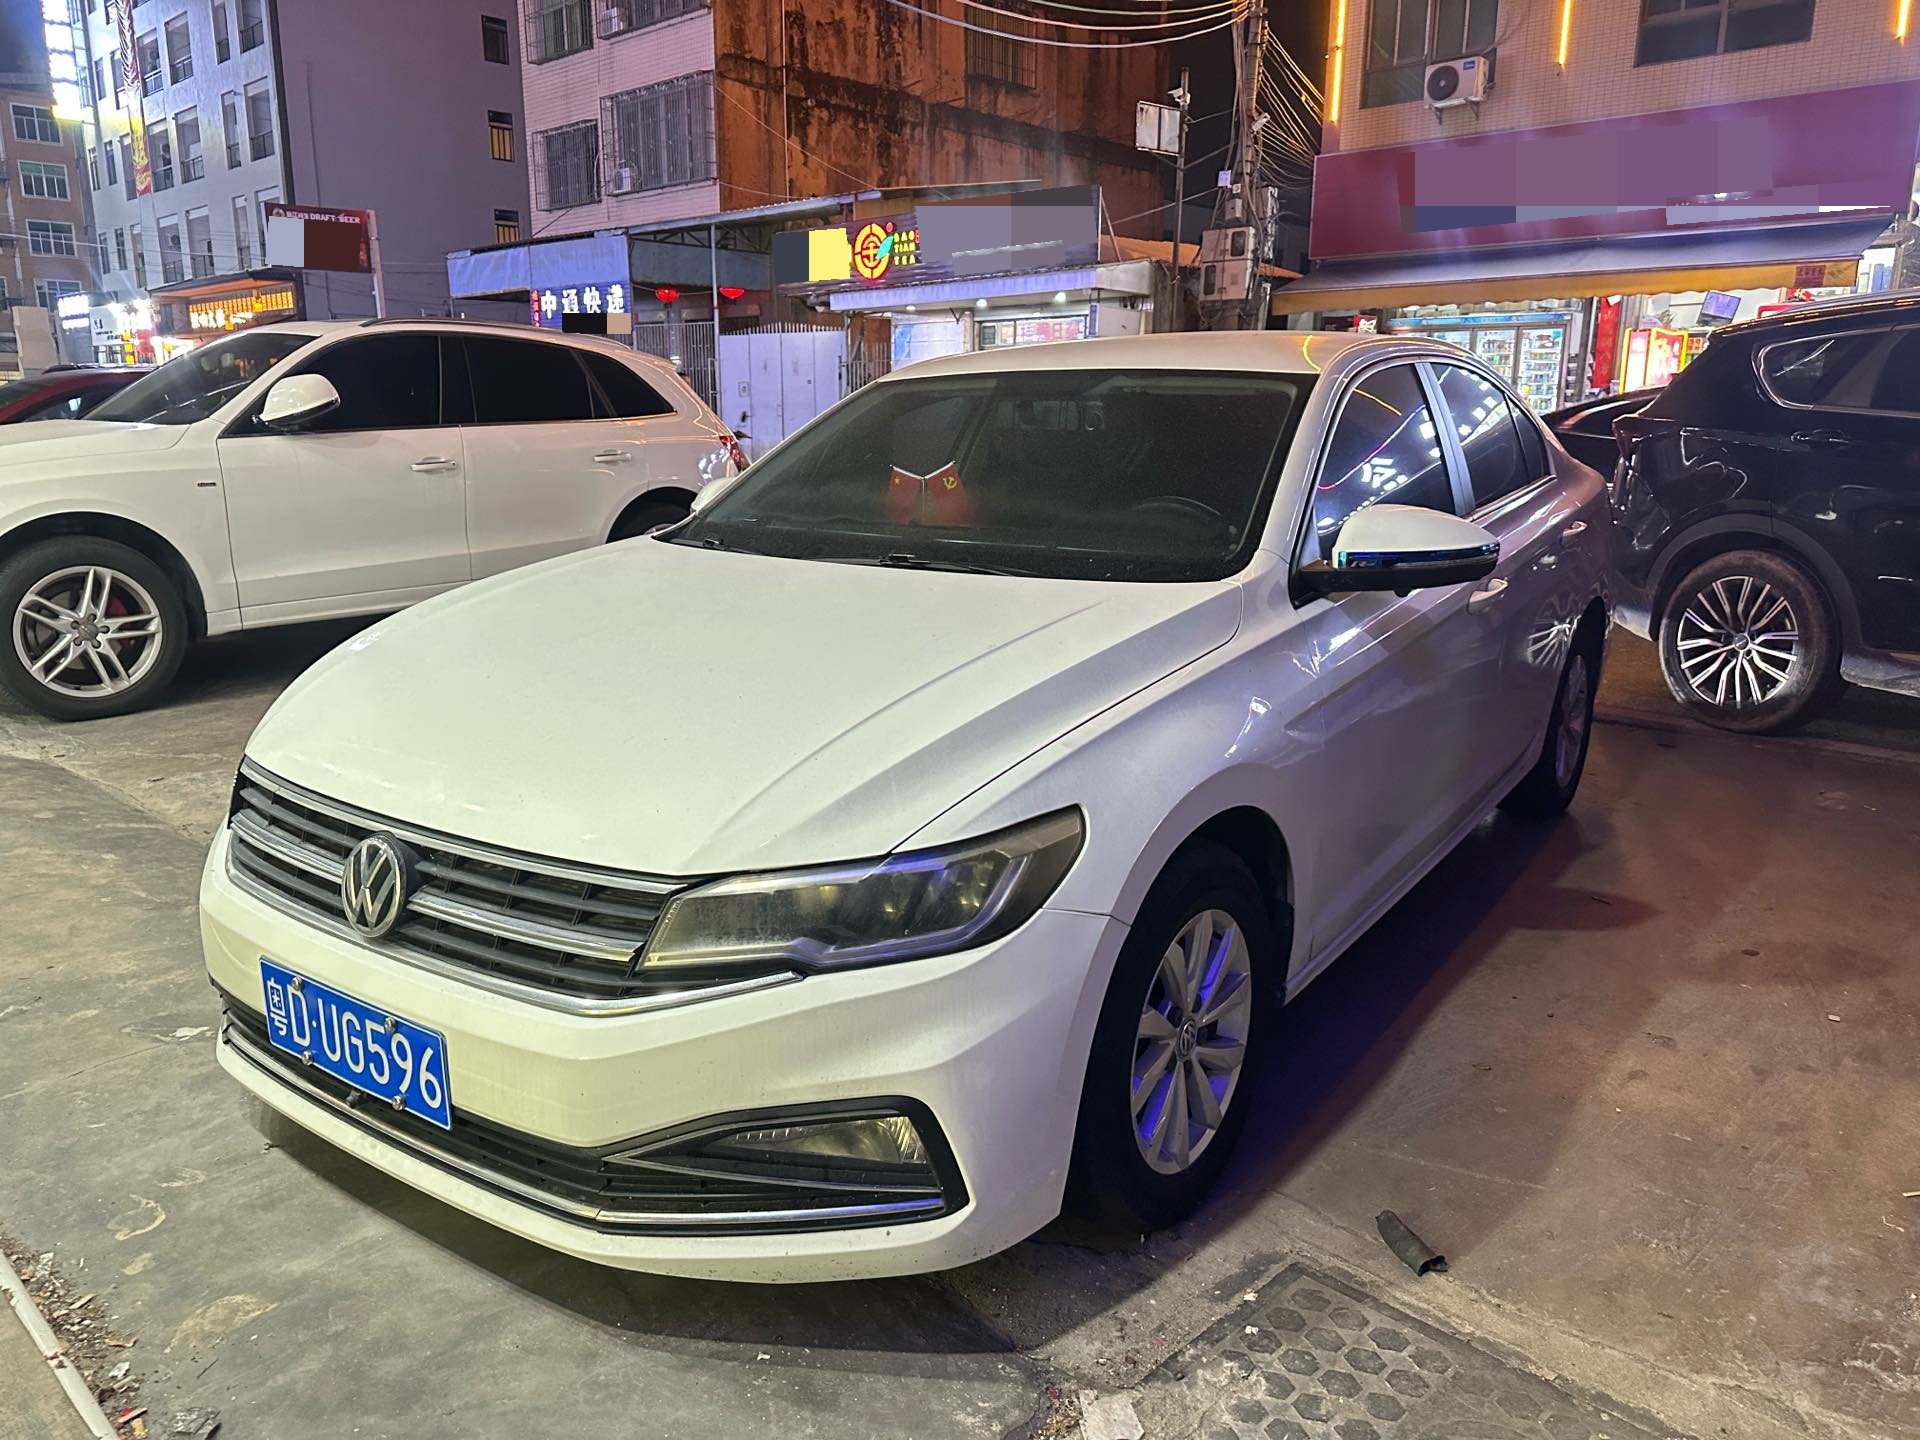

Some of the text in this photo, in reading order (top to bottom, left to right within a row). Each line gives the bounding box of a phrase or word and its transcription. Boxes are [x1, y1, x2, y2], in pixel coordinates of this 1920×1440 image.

[893, 254, 916, 266] TEA
[540, 283, 625, 320] 中通快递
